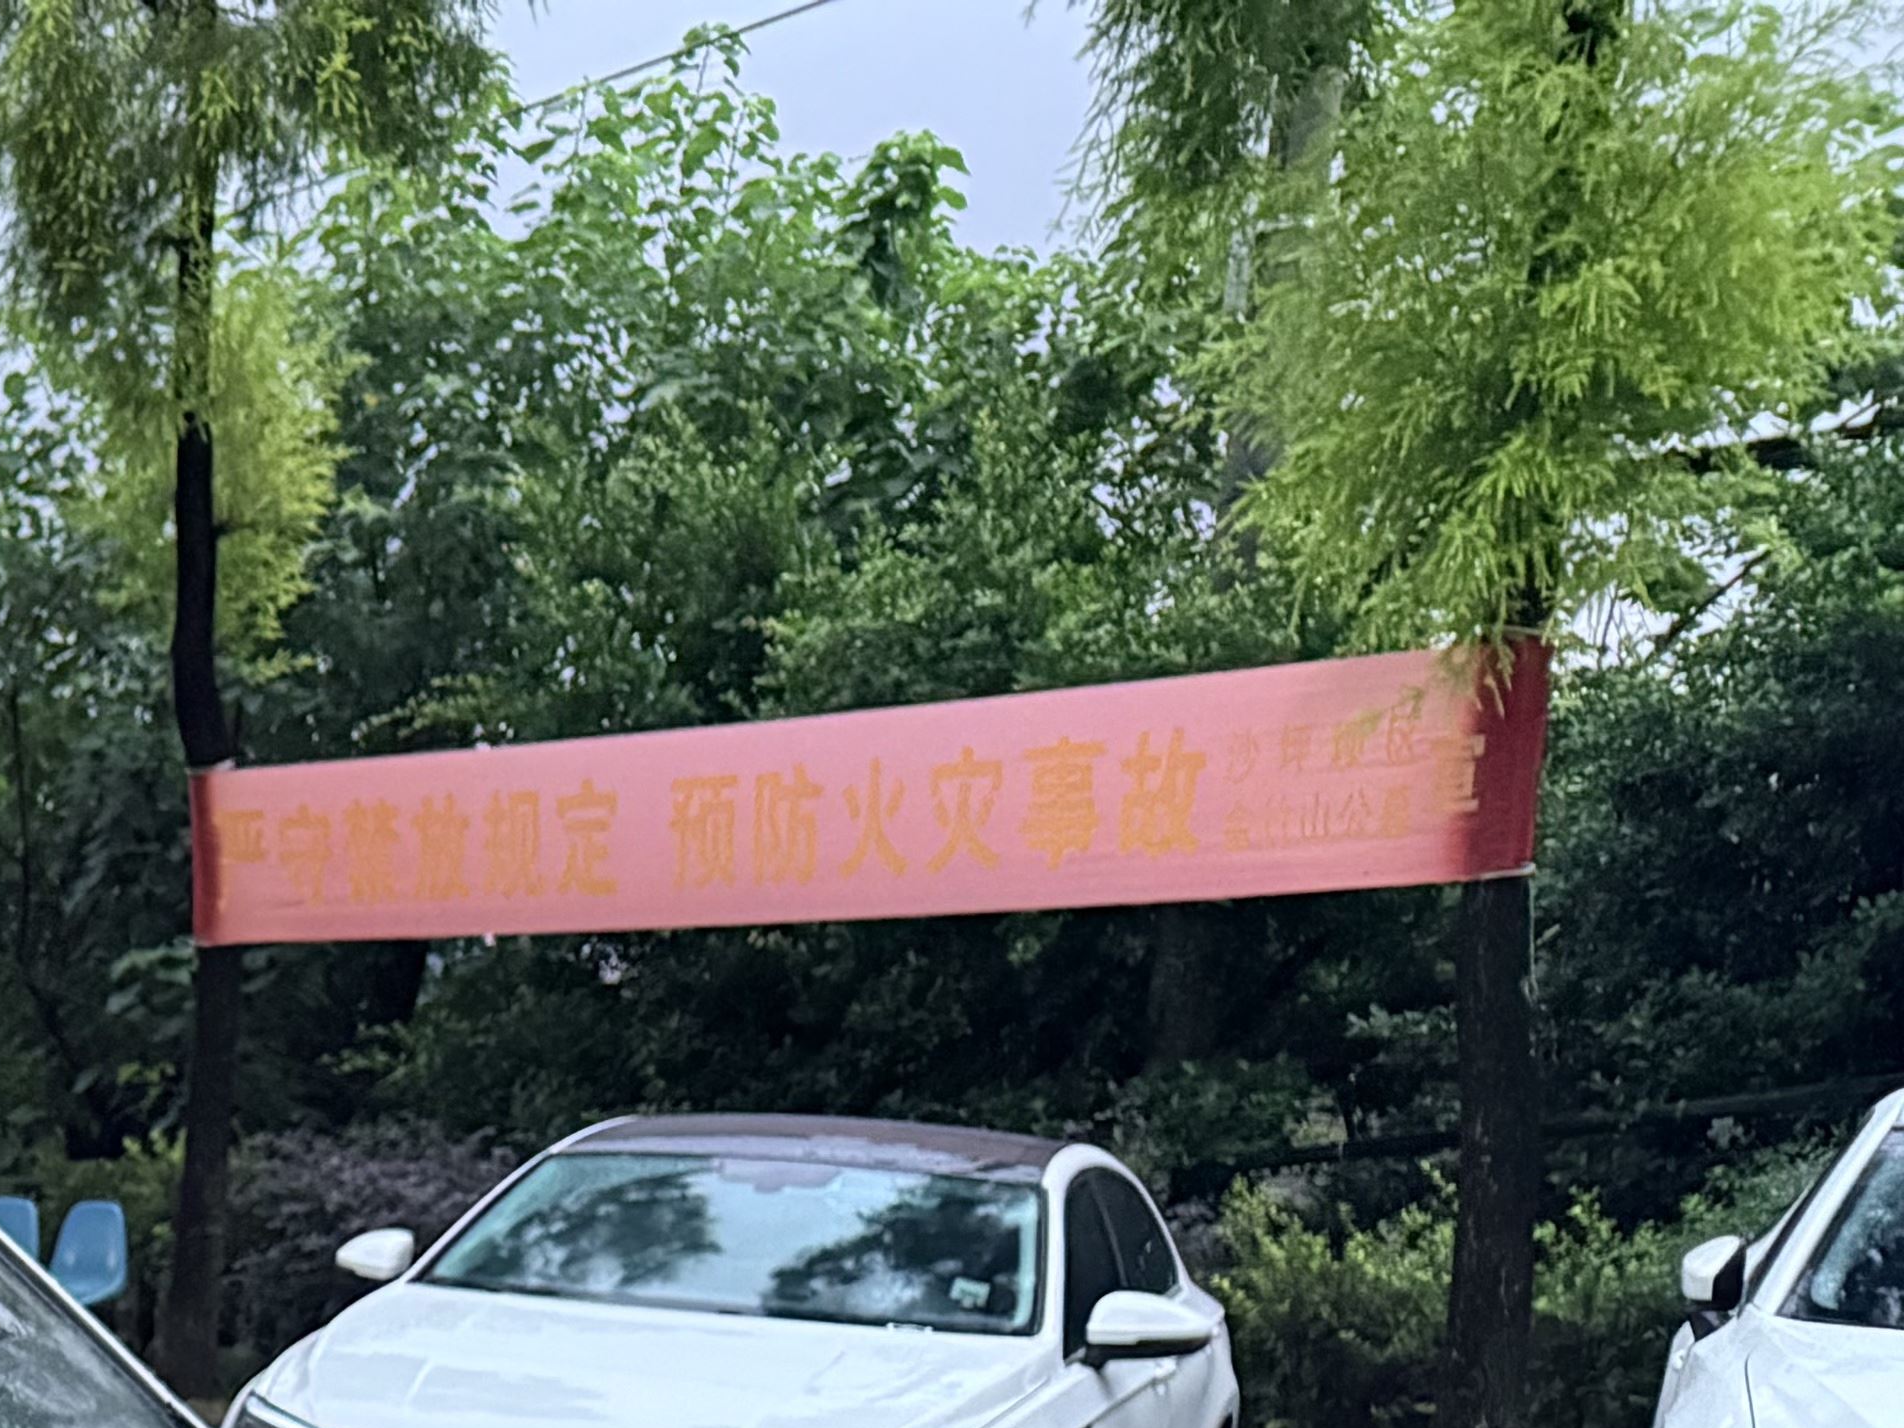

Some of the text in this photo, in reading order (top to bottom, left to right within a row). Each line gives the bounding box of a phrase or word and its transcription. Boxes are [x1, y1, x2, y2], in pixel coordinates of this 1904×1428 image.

[669, 727, 1207, 890] 预防火灾事故
